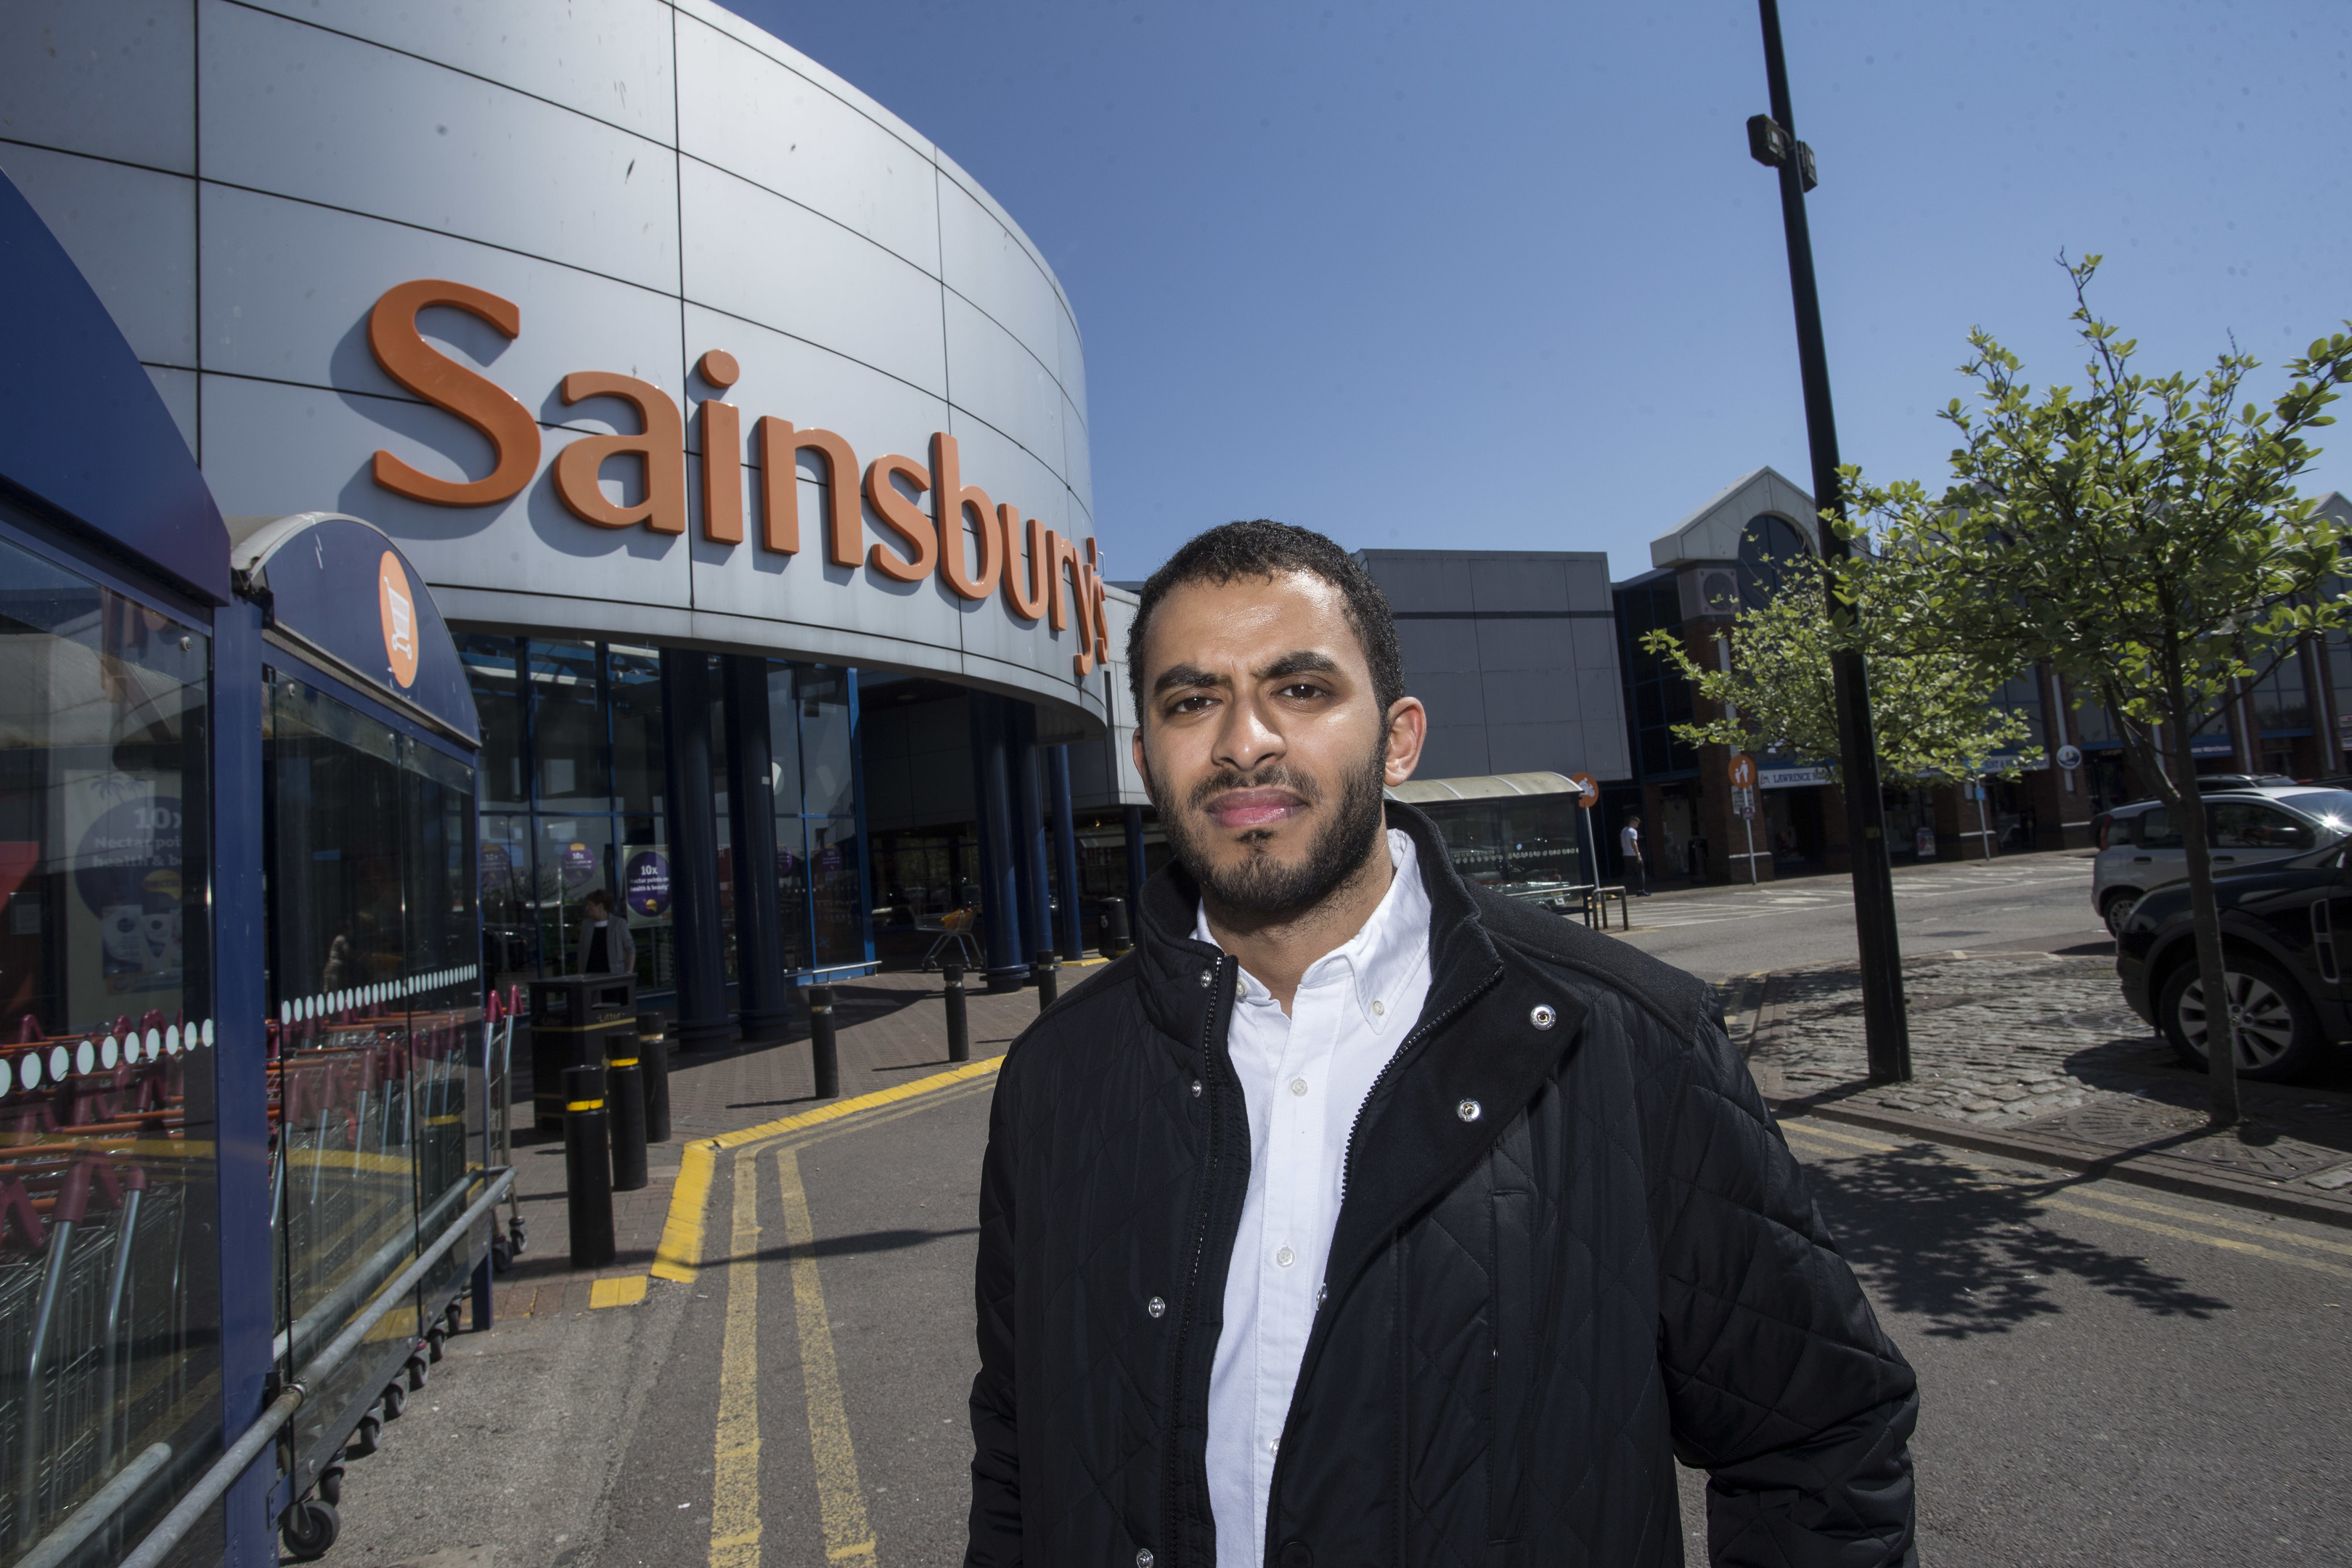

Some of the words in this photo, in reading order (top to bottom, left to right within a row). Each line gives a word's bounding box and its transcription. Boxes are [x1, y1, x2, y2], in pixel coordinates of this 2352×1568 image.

[367, 279, 1108, 675] Sainsbury's
[1773, 772, 1811, 783] LAWRENCE
[94, 837, 151, 849] Nectar
[92, 854, 149, 867] health
[152, 855, 164, 866] &
[640, 865, 658, 875] 10x
[599, 1012, 621, 1023] Litter
